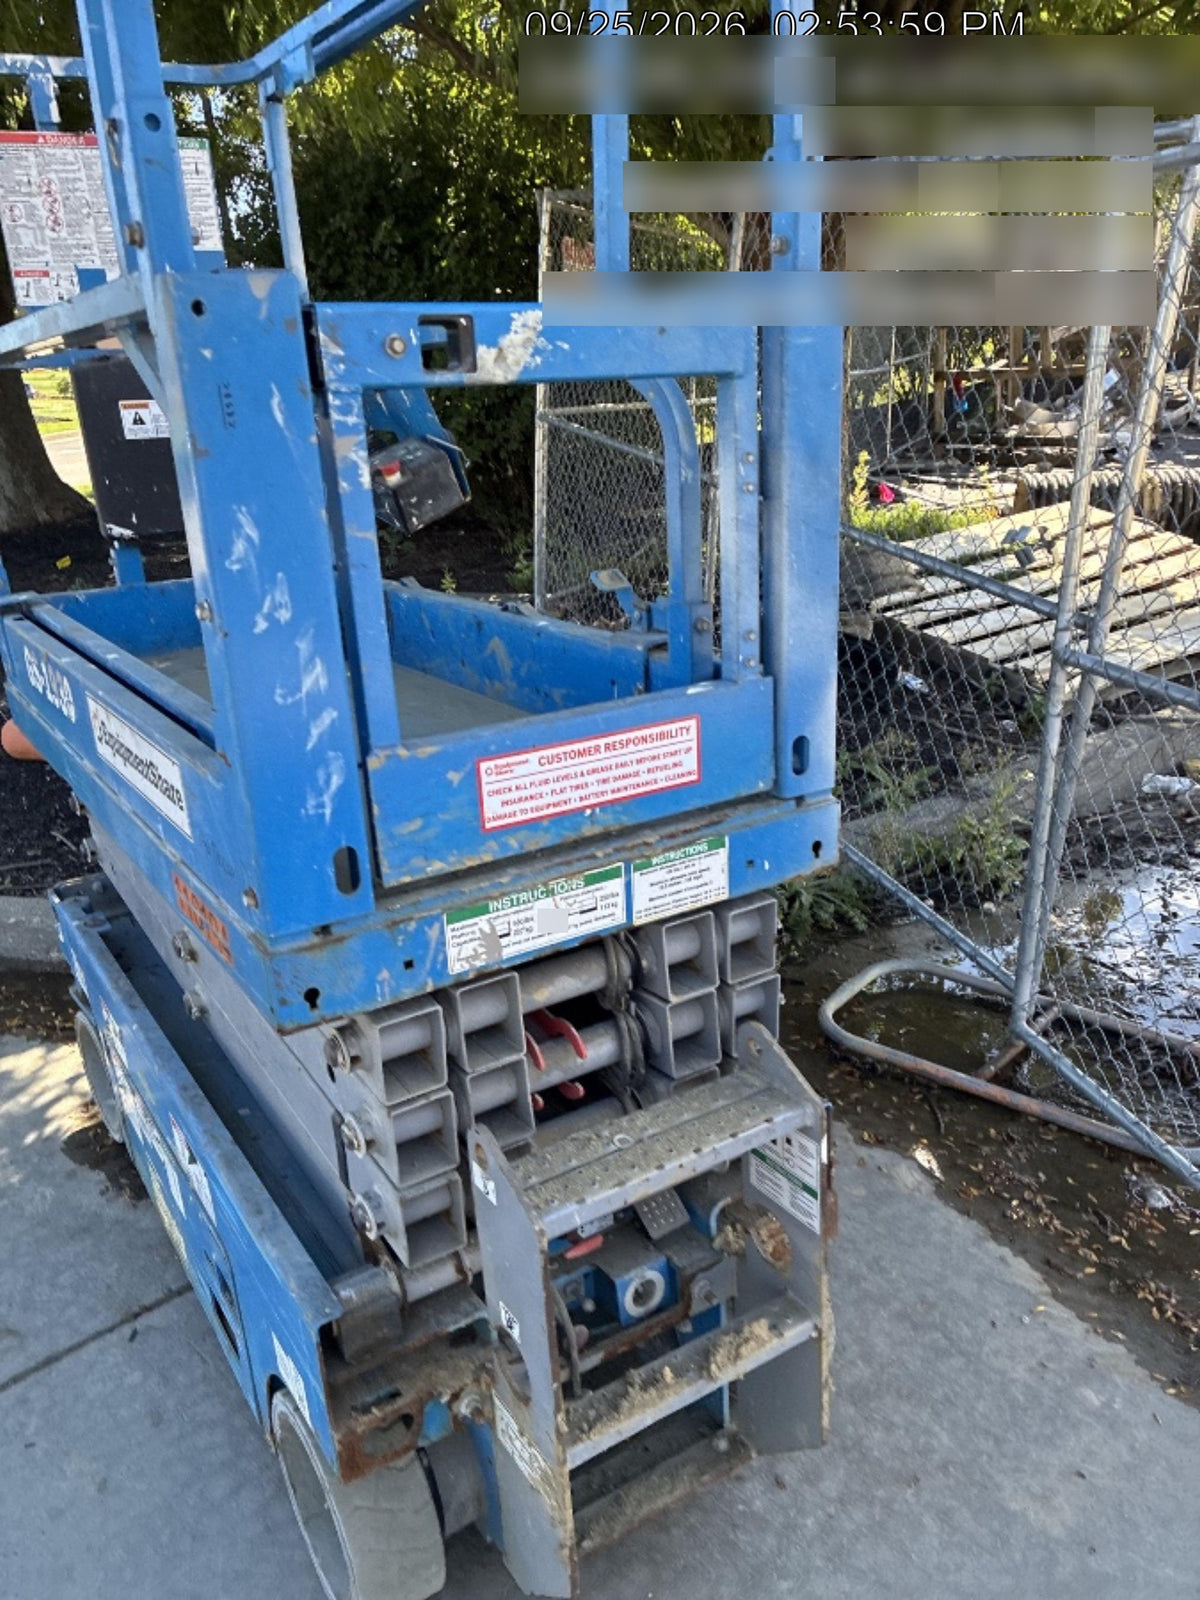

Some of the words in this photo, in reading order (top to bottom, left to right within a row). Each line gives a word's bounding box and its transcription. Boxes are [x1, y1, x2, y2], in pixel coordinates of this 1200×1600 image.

[538, 744, 602, 767] CUSTOMER
[604, 725, 692, 753] RESPONSIBILITY
[487, 786, 513, 797] CHECK
[552, 772, 579, 783] LEVELS
